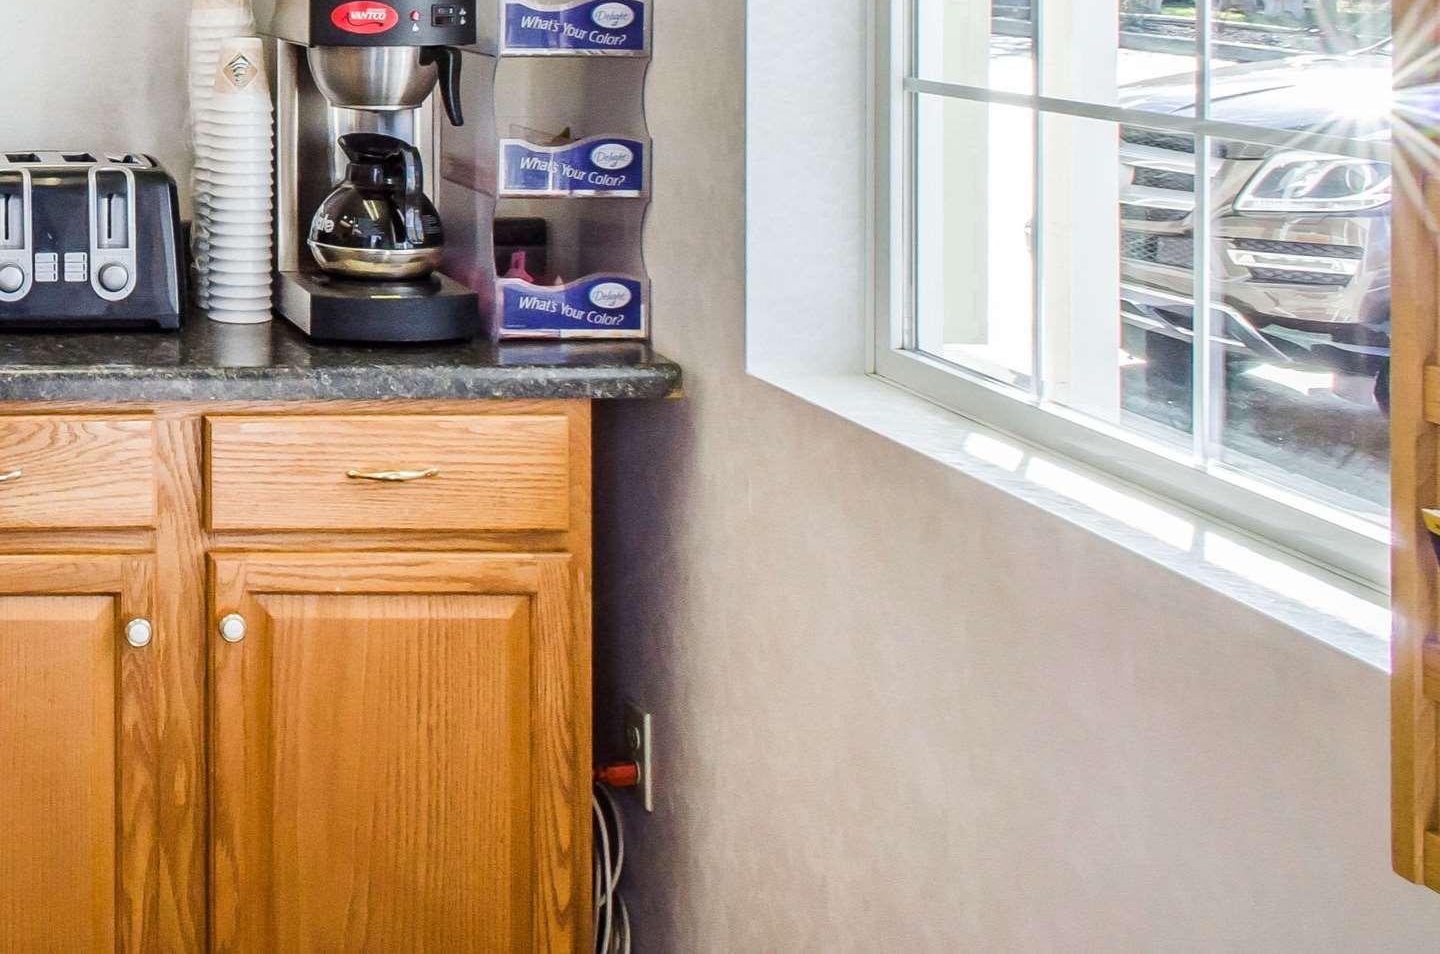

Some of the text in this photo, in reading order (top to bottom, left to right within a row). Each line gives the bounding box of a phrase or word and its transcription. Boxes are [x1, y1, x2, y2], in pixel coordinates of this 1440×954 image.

[562, 22, 588, 40] Your
[589, 30, 627, 46] Color?
[560, 163, 587, 181] Your
[588, 171, 625, 187] Color?
[559, 302, 586, 320] Your
[587, 310, 625, 326] Color?
